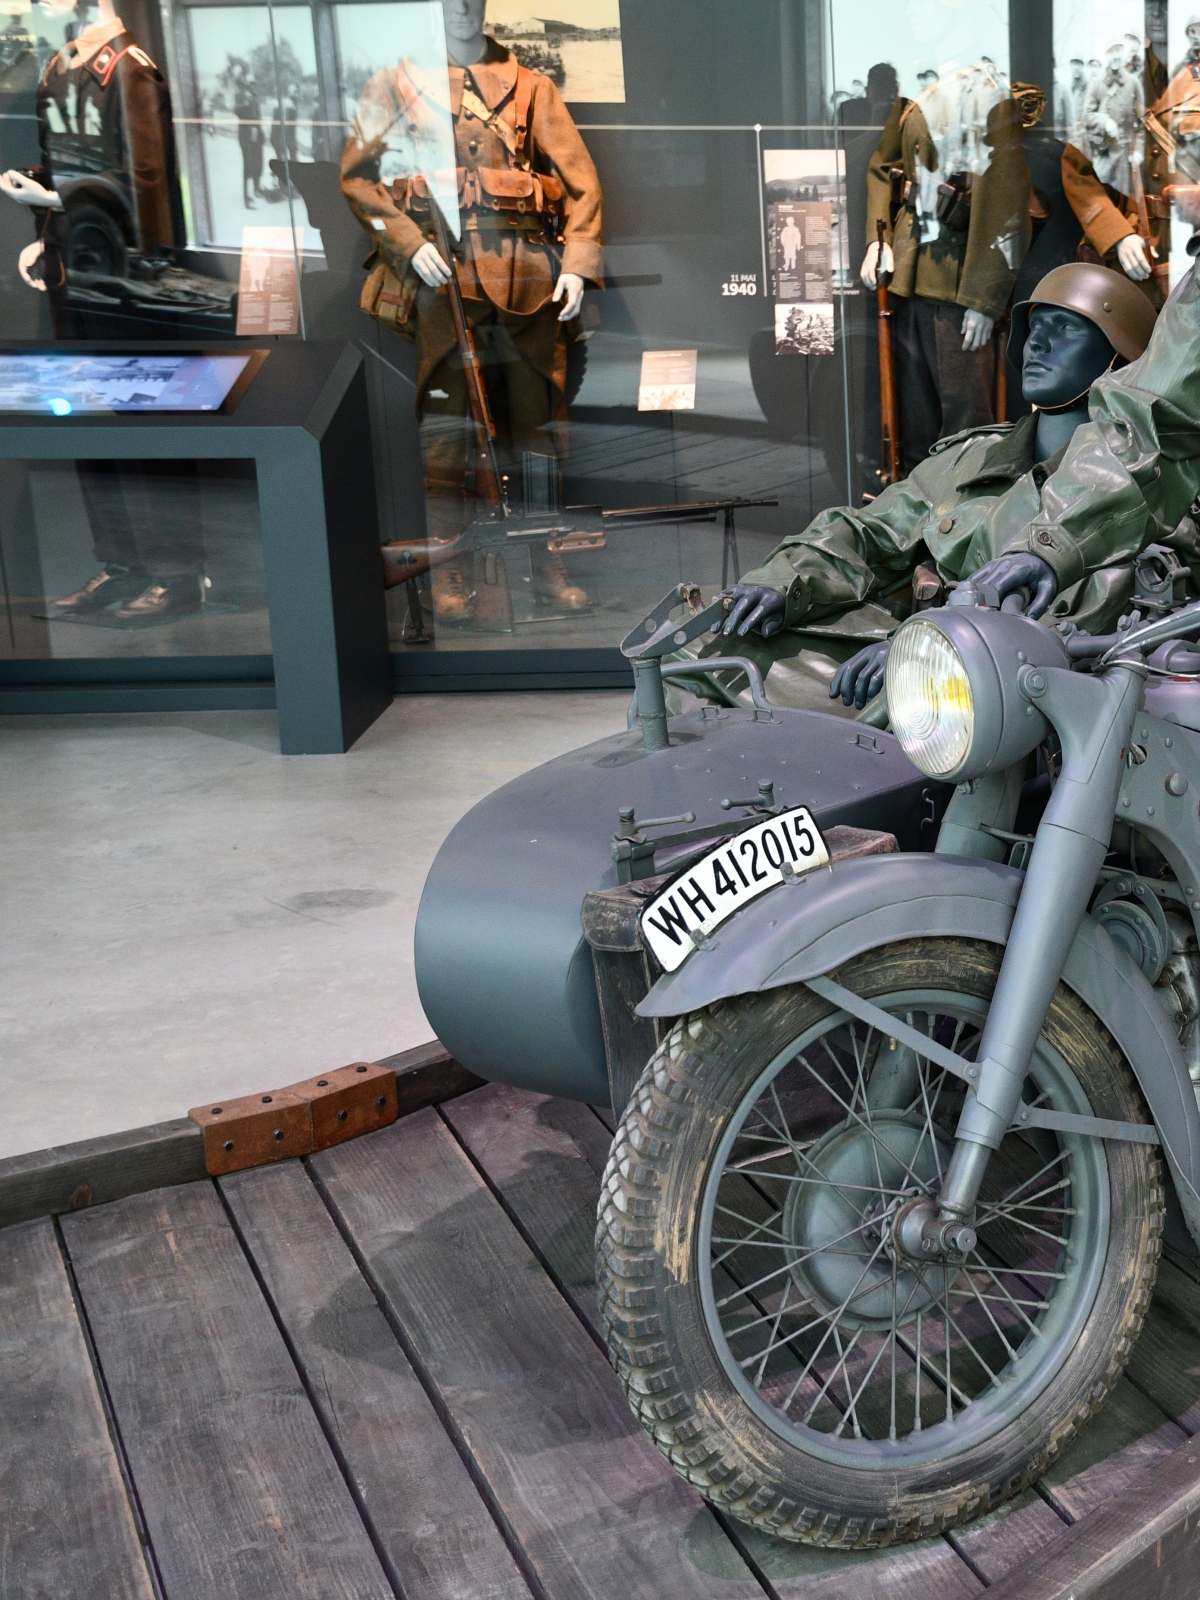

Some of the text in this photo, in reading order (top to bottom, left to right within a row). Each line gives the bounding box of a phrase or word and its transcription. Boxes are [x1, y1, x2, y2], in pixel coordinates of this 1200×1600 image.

[730, 274, 757, 282] 11 MAI
[721, 283, 757, 296] 1940
[647, 815, 815, 946] WH 412015
